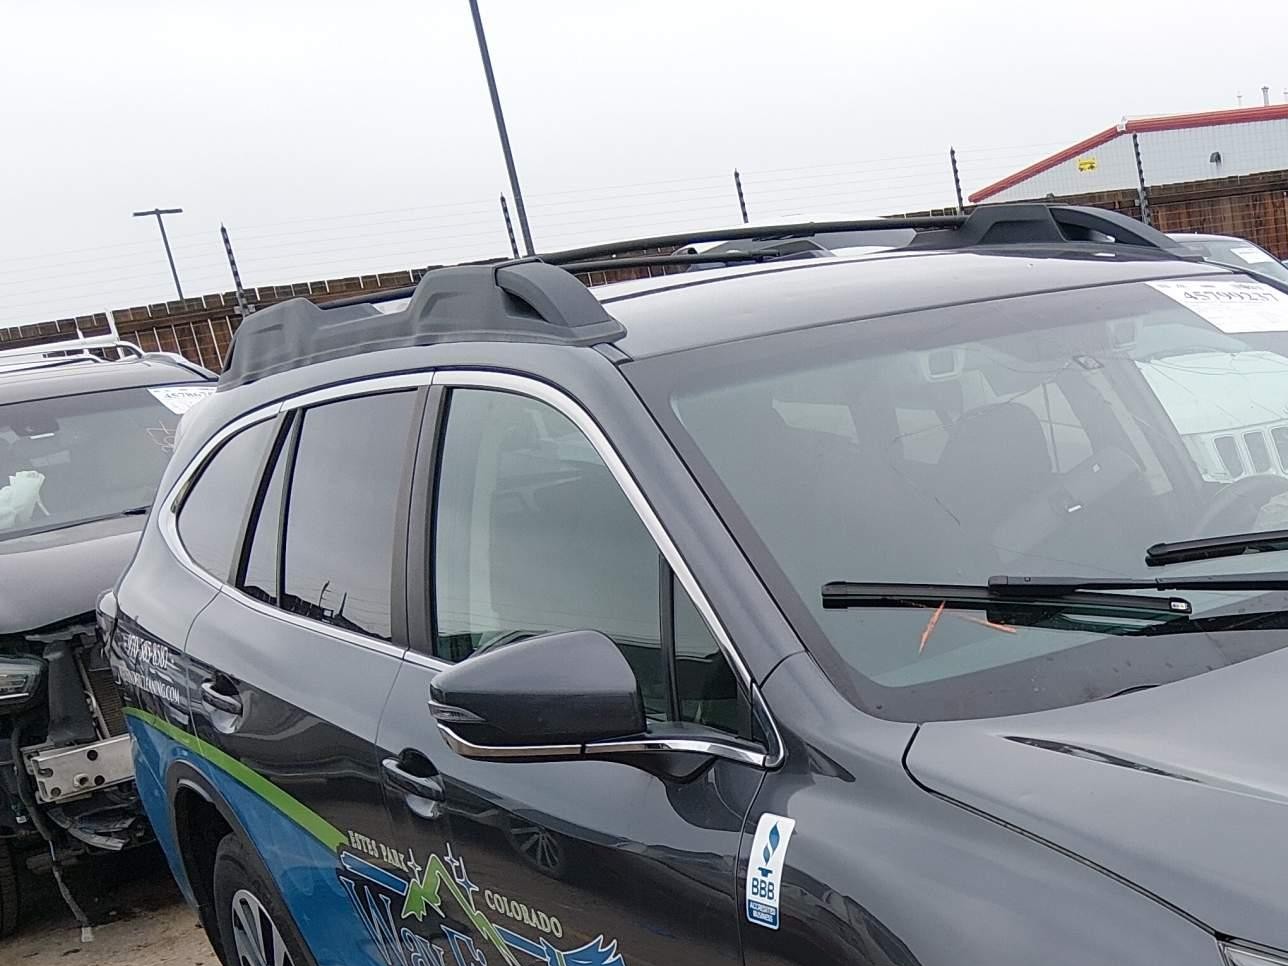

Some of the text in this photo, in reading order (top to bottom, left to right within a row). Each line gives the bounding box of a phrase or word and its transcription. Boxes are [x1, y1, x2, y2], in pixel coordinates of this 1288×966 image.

[1184, 290, 1280, 302] 45799237
[347, 830, 410, 872] ESTES PARK
[751, 877, 775, 900] BBB
[484, 889, 563, 938] COLORADO
